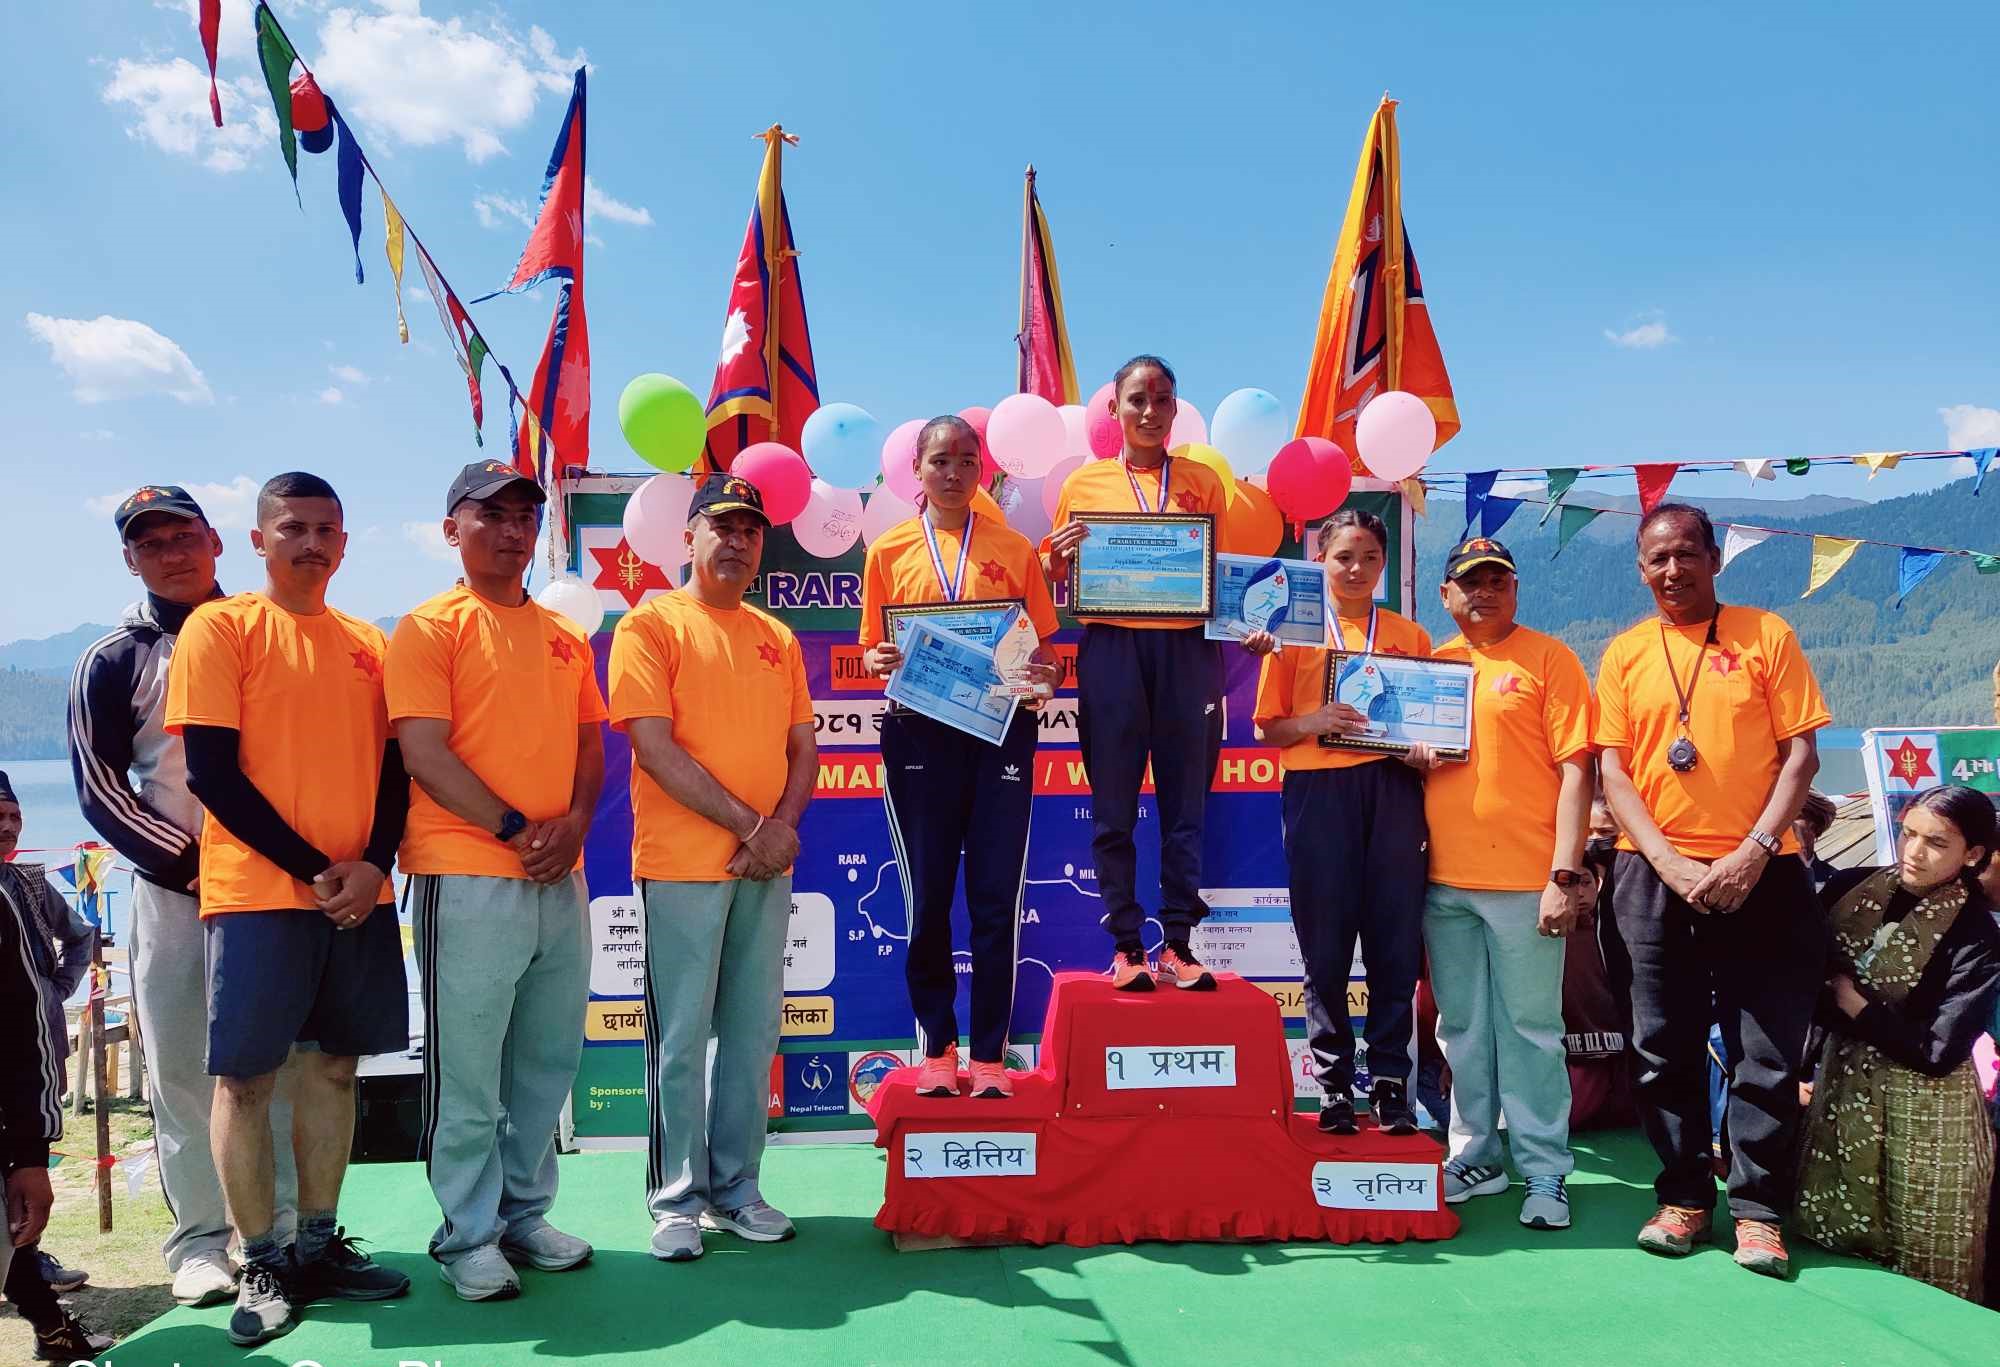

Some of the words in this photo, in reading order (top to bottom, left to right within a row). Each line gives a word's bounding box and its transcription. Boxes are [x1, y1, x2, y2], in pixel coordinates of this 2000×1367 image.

[768, 572, 864, 609] RAR
[838, 854, 867, 865] RARA
[1107, 1051, 1125, 1080] १
[1147, 1050, 1226, 1077] प्रथम
[590, 1086, 646, 1097] Sponsore
[790, 1105, 812, 1115] Nepal
[813, 1104, 845, 1113] Telecom
[906, 1148, 923, 1171] २
[1314, 1177, 1332, 1197] ३
